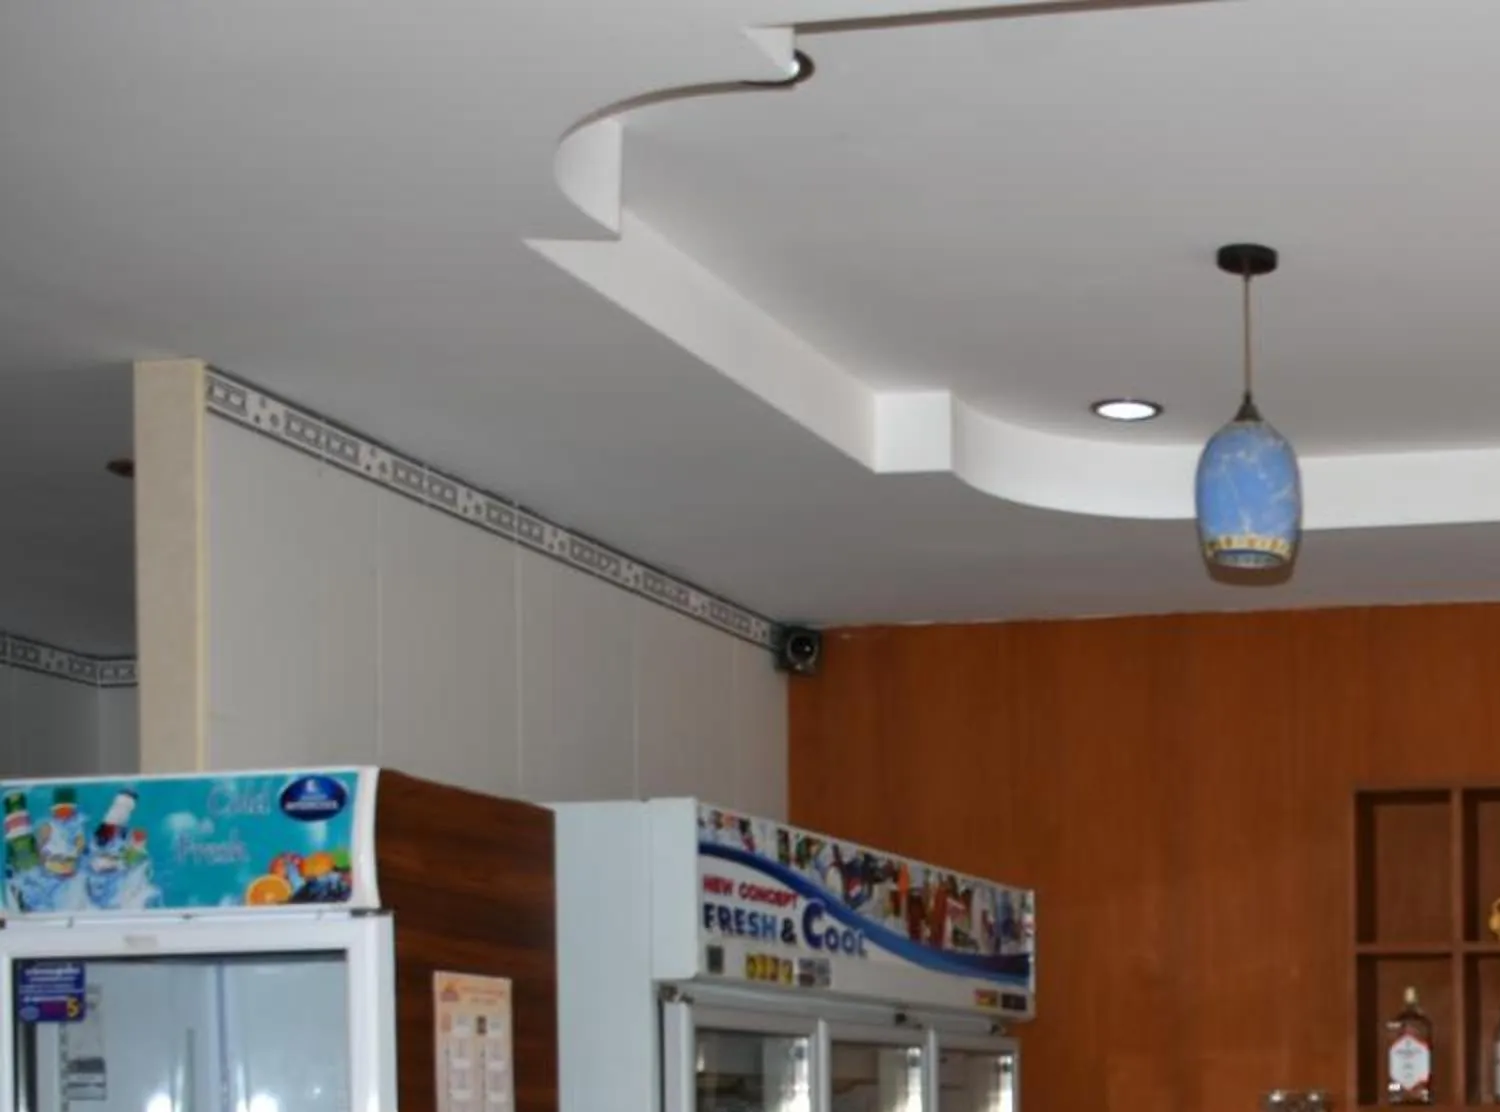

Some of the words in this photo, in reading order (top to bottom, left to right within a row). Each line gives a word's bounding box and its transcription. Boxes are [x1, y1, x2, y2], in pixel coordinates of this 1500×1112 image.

[703, 875, 734, 896] NEW
[738, 882, 799, 909] CONCEPT
[704, 904, 777, 942] FRESH
[781, 917, 797, 944] &
